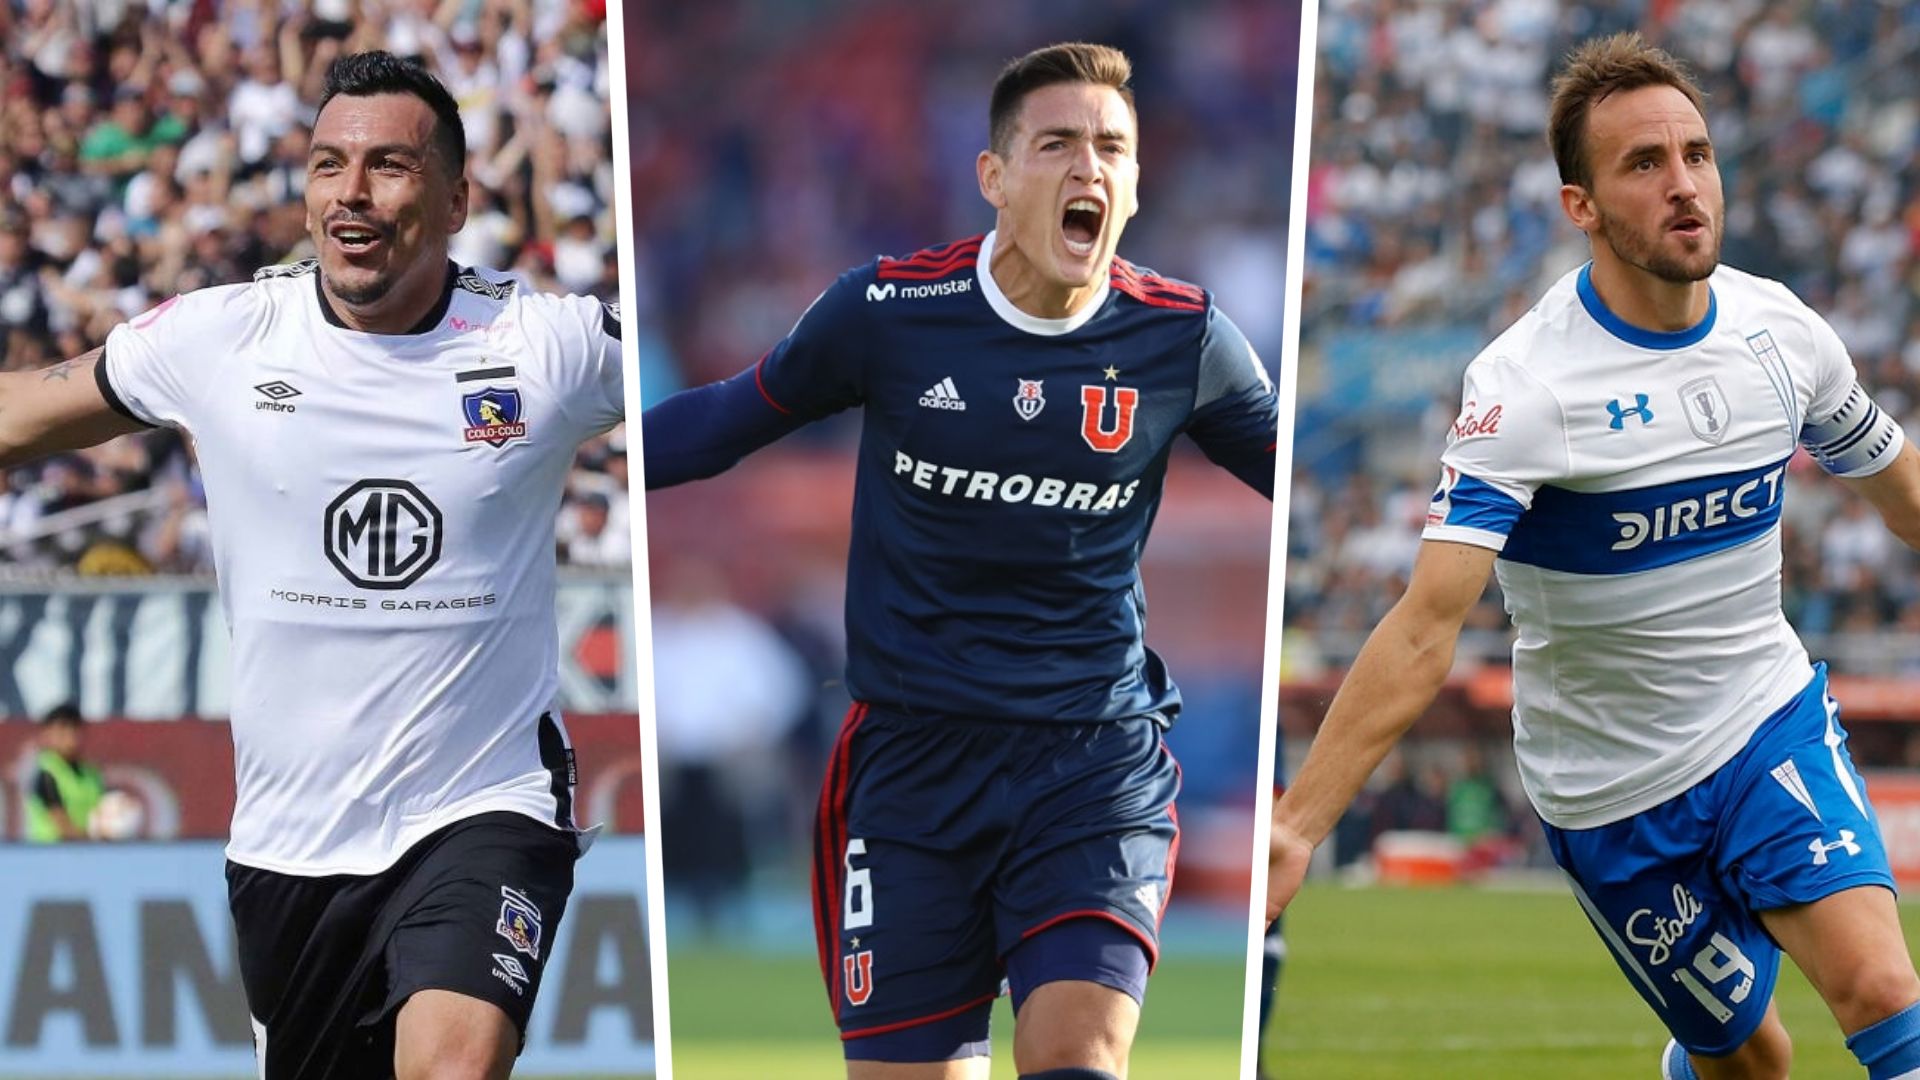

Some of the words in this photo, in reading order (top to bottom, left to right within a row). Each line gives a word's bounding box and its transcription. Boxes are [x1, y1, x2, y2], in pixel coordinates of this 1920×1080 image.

[900, 278, 973, 299] movistar
[255, 401, 296, 413] umbro
[466, 425, 524, 440] COLO-COLO
[918, 396, 967, 411] adidas
[1081, 385, 1139, 453] U
[894, 450, 1140, 512] PETROBRAS
[1611, 466, 1784, 551] DIRECT
[338, 492, 429, 577] MG
[270, 589, 367, 610] MORRIS
[381, 593, 497, 611] GARAGES
[843, 838, 873, 930] 6
[1626, 883, 1703, 966] Stoli
[491, 967, 523, 996] umbro
[843, 950, 873, 1006] U
[1671, 931, 1756, 1024] 19
